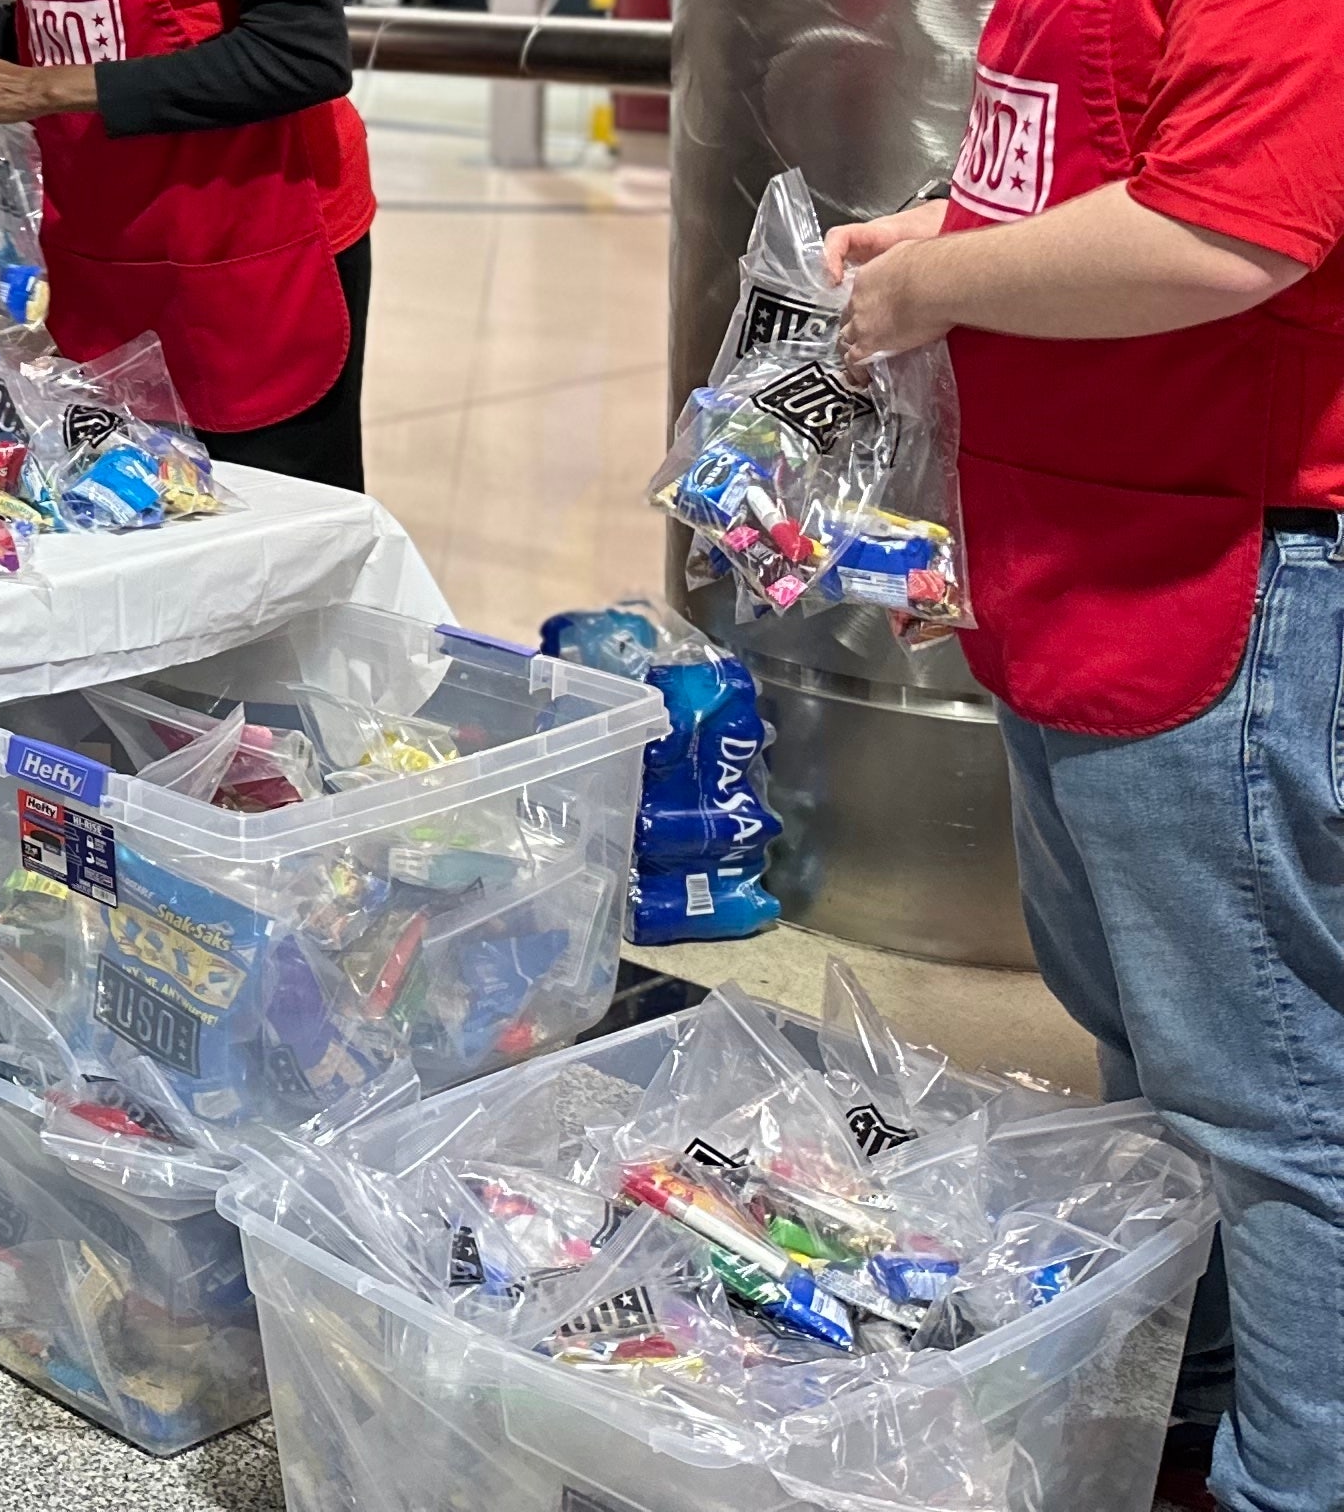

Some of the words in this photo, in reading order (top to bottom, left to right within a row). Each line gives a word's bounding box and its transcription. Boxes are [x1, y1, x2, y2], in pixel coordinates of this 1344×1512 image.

[26, 9, 92, 66] USO
[783, 382, 850, 434] US
[23, 752, 83, 793] Hefty
[27, 797, 57, 818] Hefty
[713, 735, 763, 878] DASANI
[115, 979, 175, 1055] USO
